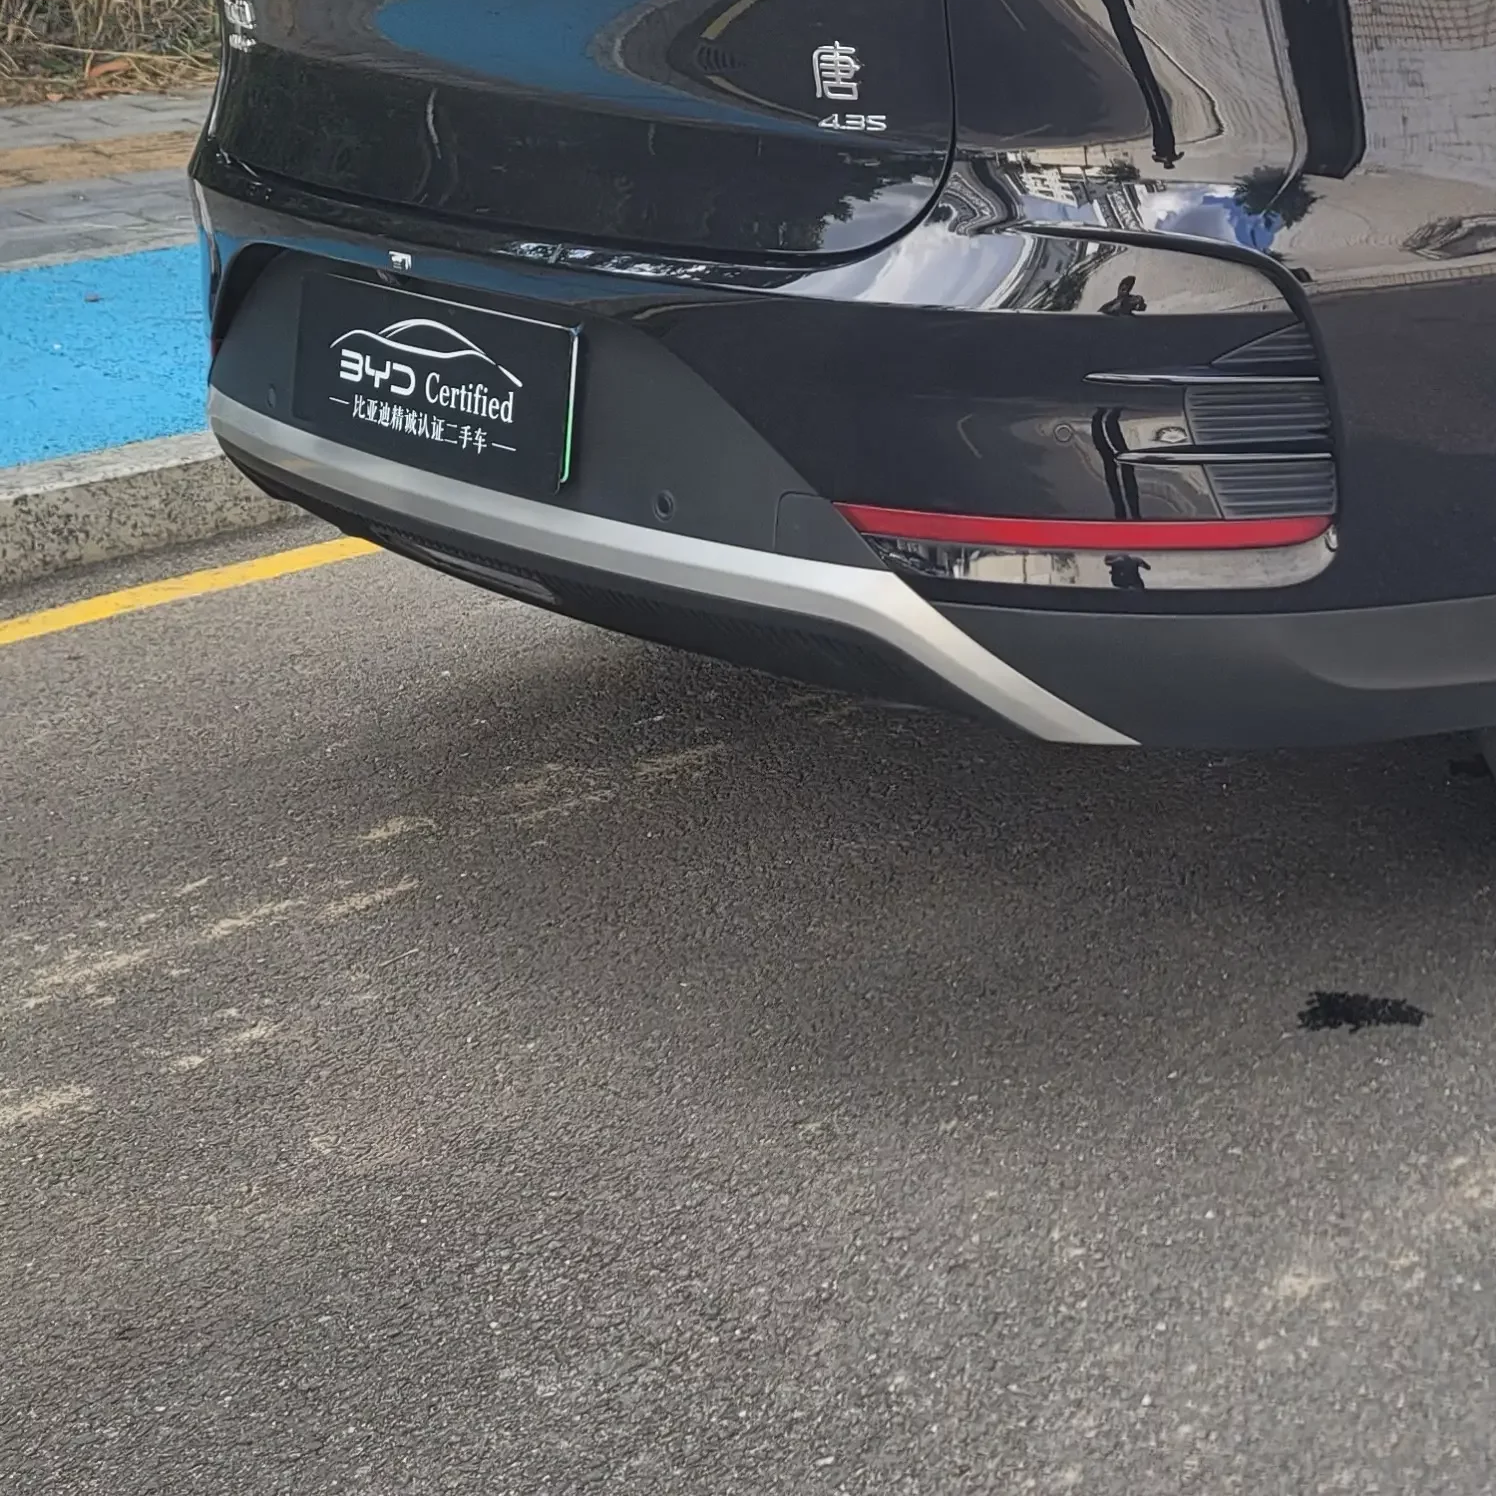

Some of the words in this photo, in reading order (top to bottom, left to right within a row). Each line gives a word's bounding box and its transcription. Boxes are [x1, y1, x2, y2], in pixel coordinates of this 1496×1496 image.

[812, 40, 861, 100] 唐
[339, 348, 416, 396] BYD
[425, 371, 515, 424] Certified
[352, 394, 488, 454] 比亚迪精诚认证二手车
